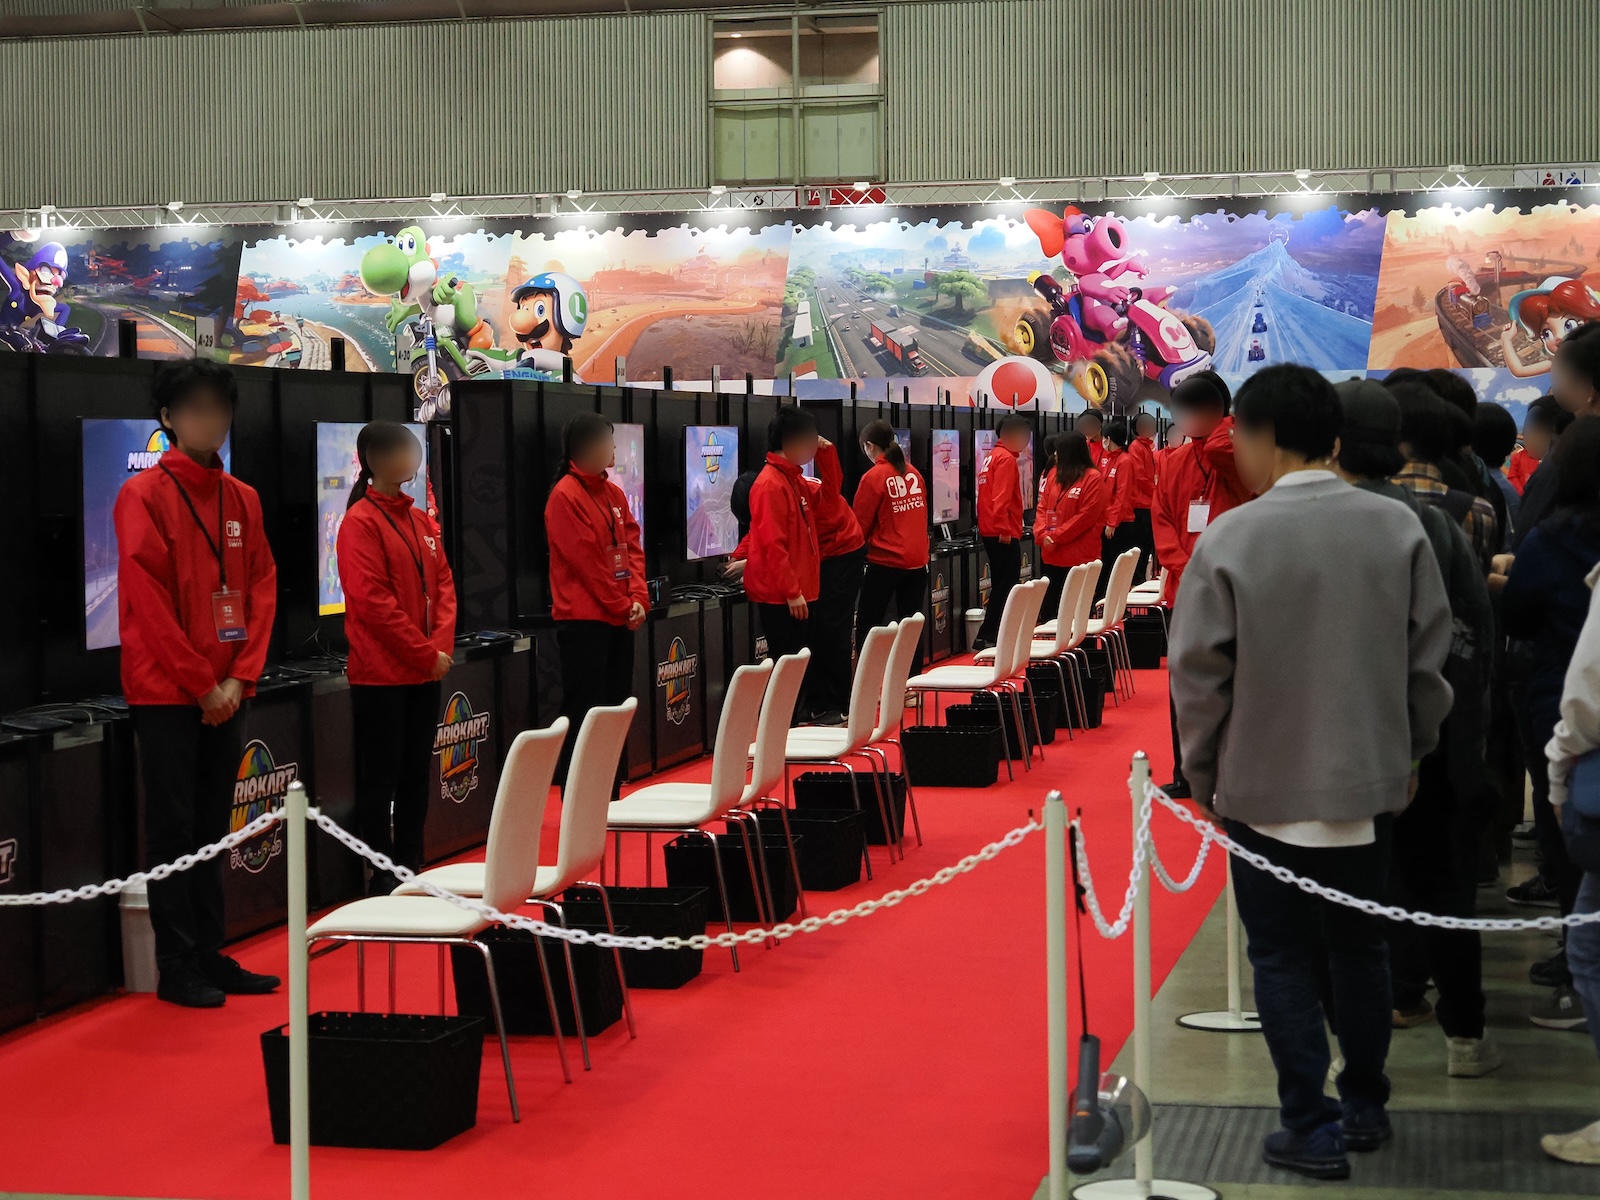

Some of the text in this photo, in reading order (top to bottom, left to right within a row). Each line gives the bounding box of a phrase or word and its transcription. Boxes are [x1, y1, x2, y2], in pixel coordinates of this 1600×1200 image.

[806, 190, 836, 201] HAL
[575, 294, 585, 319] L
[198, 335, 214, 347] A-29
[398, 350, 411, 361] A-30
[906, 473, 922, 494] 2
[433, 716, 488, 749] ARIOKART
